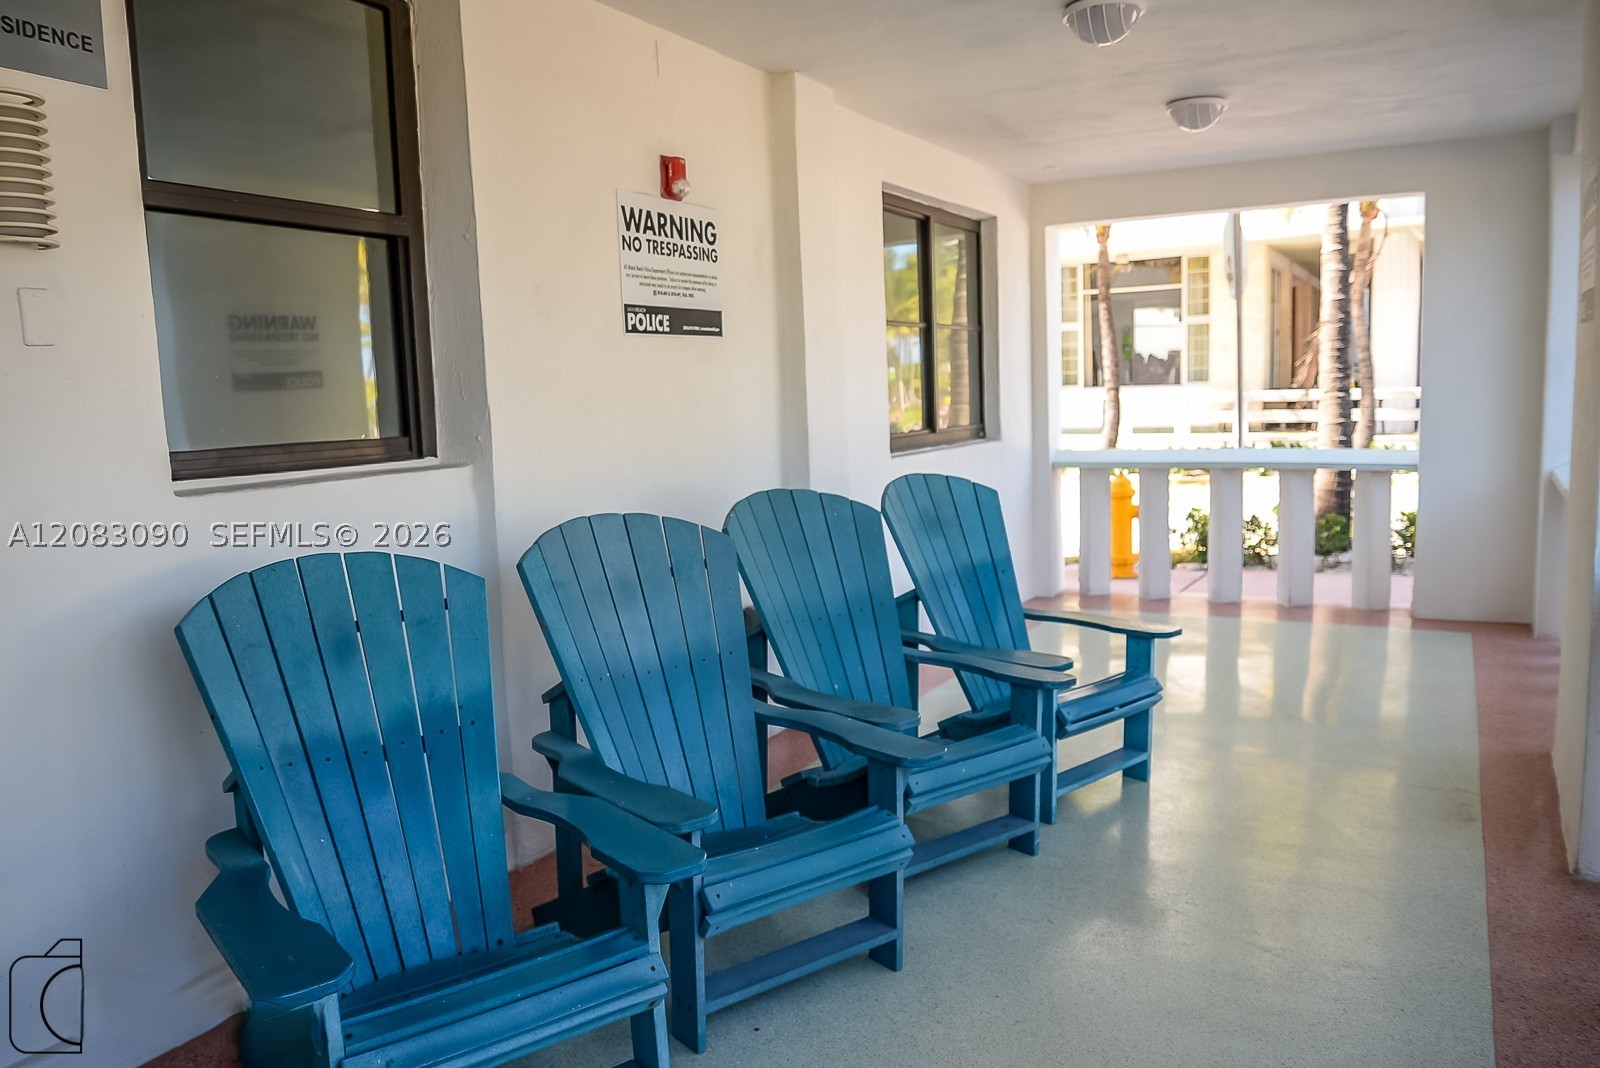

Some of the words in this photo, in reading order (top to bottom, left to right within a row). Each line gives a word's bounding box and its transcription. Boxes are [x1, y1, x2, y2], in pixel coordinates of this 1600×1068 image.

[0, 15, 94, 53] SIDENCE
[620, 204, 717, 246] WARNING
[621, 234, 642, 253] NO
[645, 238, 718, 263] TRESPASSING
[627, 312, 670, 332] POLICE
